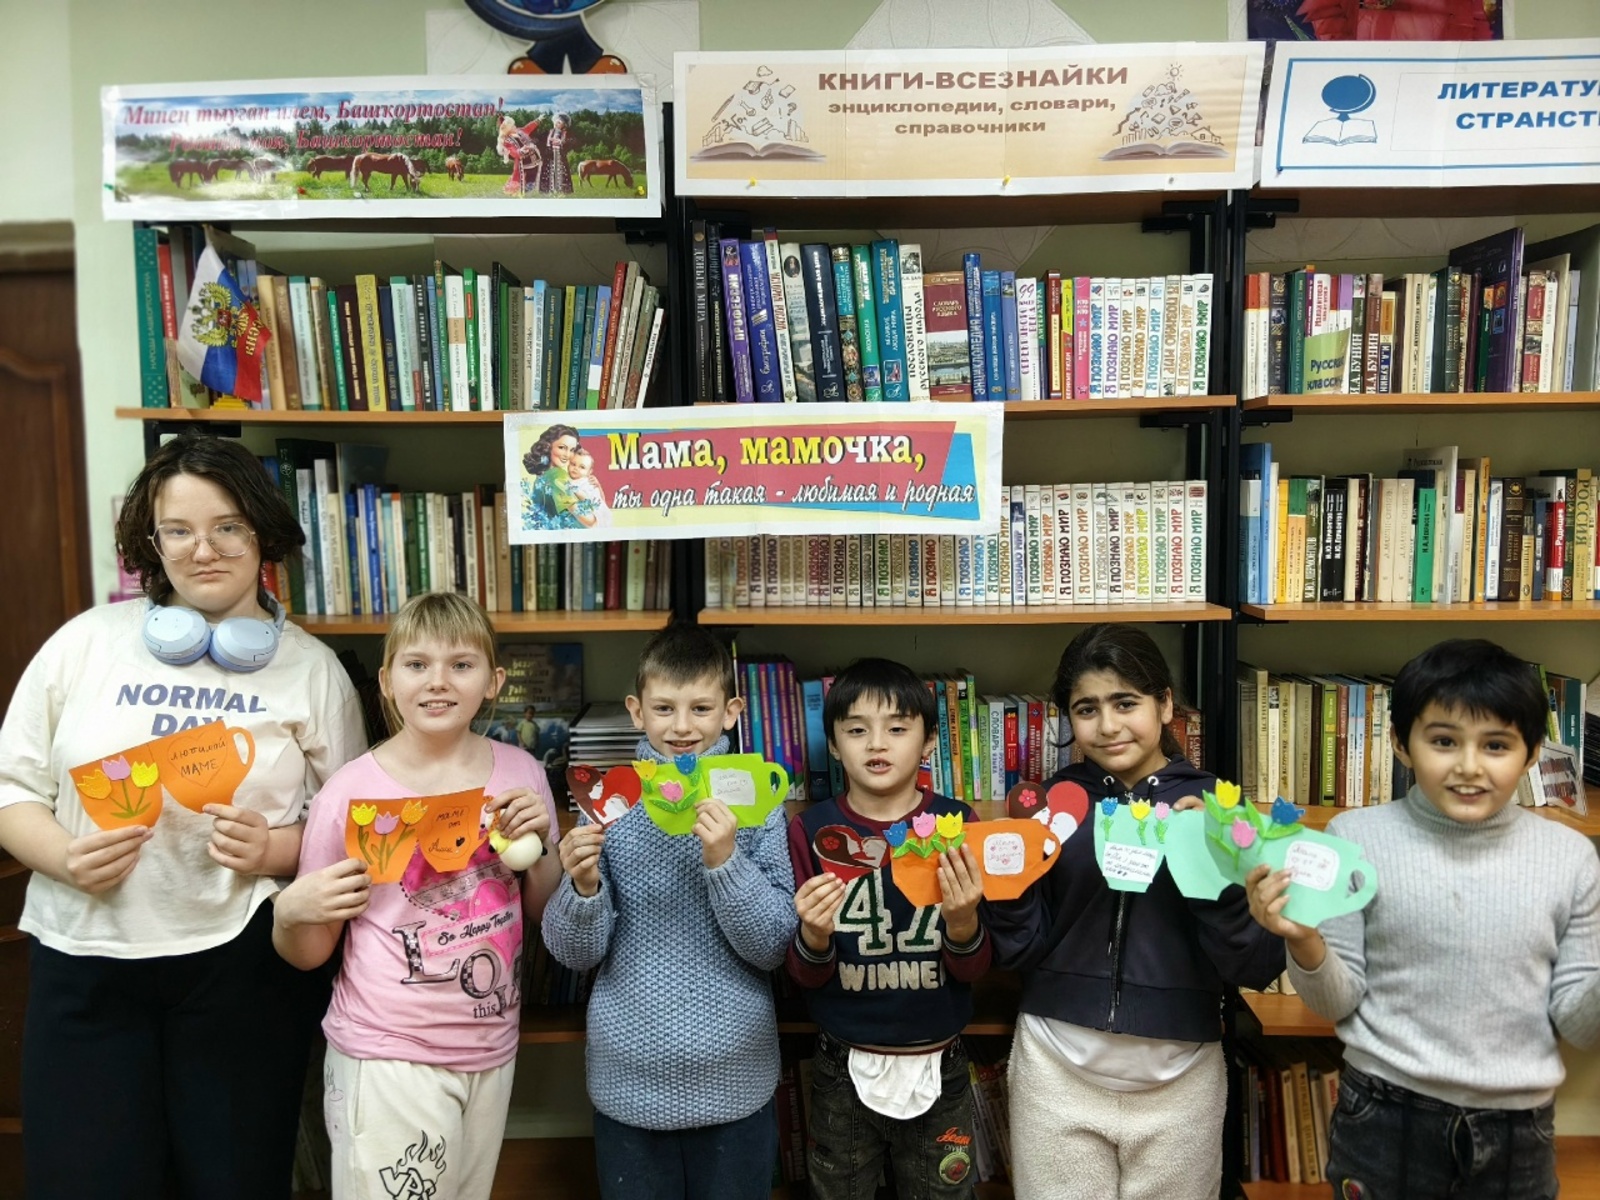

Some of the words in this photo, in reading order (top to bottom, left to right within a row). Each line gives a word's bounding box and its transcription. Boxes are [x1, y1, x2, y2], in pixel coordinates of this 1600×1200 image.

[817, 64, 1130, 92] КНИГИ-ВСЕЗНАЙКИ
[1438, 80, 1600, 99] ЛИТЕРАТУ
[828, 97, 1004, 117] энциклопедии,
[1010, 96, 1117, 114] словари,
[1456, 110, 1600, 129] СТРАНСТ
[894, 118, 1046, 137] справочники
[693, 247, 706, 290] ДЕНЬГИ
[1019, 284, 1035, 297] 99
[1168, 282, 1180, 295] Я
[696, 293, 707, 322] МИРА
[728, 273, 747, 341] ПРОФЕССИИ
[1091, 303, 1102, 330] МИР
[1108, 304, 1119, 330] МИР
[1136, 305, 1146, 330] МИР
[1150, 308, 1161, 332] МИР
[1197, 300, 1208, 326] МИР
[1122, 309, 1132, 333] МИР
[1165, 297, 1178, 346] ПОЗНАЮ
[970, 319, 986, 395] ЭНЦИКЛОПЕДИЯ
[1091, 333, 1102, 381] ПОЗНАЮ
[1106, 333, 1118, 381] ПОЗНАЮ
[1121, 336, 1132, 380] ПОЗНАЮ
[1133, 332, 1145, 378] ПОЗНАЮ
[1147, 335, 1160, 379] ПОЗНАЮ
[1163, 348, 1176, 374] МИР
[1194, 330, 1207, 378] ПОЗНАЮ
[1352, 334, 1362, 372] БУНИН
[1368, 333, 1379, 371] БУНИН
[1381, 345, 1390, 362] И.А.
[1090, 384, 1102, 393] Я
[1105, 384, 1117, 393] Я
[1120, 383, 1130, 391] Я
[1132, 379, 1144, 388] Я
[1146, 382, 1157, 390] Я
[1193, 381, 1205, 390] Я
[1380, 364, 1389, 392] БУНИН
[606, 432, 729, 476] Мама,
[740, 432, 927, 473] мамочка,
[613, 483, 643, 510] ты
[650, 487, 696, 516] одна
[704, 484, 767, 506] такая
[792, 474, 879, 505] любимая
[884, 482, 899, 503] и
[904, 480, 976, 513] родная
[1058, 508, 1070, 533] МИР
[1077, 507, 1089, 532] МИР
[1108, 507, 1119, 532] МИР
[1155, 507, 1167, 533] МИР
[1171, 508, 1182, 533] МИР
[1191, 509, 1202, 534] МИР
[1575, 479, 1590, 545] РОССИЯ
[1001, 515, 1010, 538] МИР
[1029, 514, 1039, 537] МИР
[1555, 508, 1564, 546] Радищев
[767, 538, 778, 584] ПОЗНАЮ
[834, 538, 845, 584] ПОЗНАЮ
[878, 539, 889, 585] ПОЗНАЮ
[908, 539, 919, 587] ПОЗНАЮ
[925, 539, 936, 586] ПОЗНАЮ
[1000, 540, 1010, 583] ПОЗНАЮ
[1029, 540, 1040, 583] ПОЗНАЮ
[1059, 537, 1071, 584] ПОЗНАЮ
[1078, 536, 1090, 582] ПОЗНАЮ
[1110, 535, 1121, 582] ПОЗНАЮ
[1155, 536, 1167, 582] ПОЗНАЮ
[1171, 535, 1183, 582] ПОЗНАЮ
[1190, 535, 1202, 582] ПОЗНАЮ
[1305, 537, 1317, 580] ЛЕРМОНТОВ
[767, 586, 778, 595] Я
[833, 586, 844, 595] Я
[877, 588, 889, 597] Я
[907, 589, 919, 598] Я
[925, 588, 937, 597] Я
[959, 587, 971, 596] Я
[1000, 586, 1010, 594] Я
[1029, 585, 1040, 593] Я
[1060, 585, 1072, 595] Я
[1109, 585, 1121, 593] Я
[1155, 585, 1167, 594] Я
[1171, 585, 1183, 593] Я
[1190, 585, 1202, 593] Я
[116, 684, 267, 713] NORMAL
[991, 710, 999, 751] СЛОВАРЬ
[180, 758, 219, 778] МАМЕ
[438, 931, 456, 946] So
[460, 921, 491, 938] Happy
[490, 910, 514, 929] Together
[838, 960, 946, 993] WINNE
[473, 1002, 497, 1020] this
